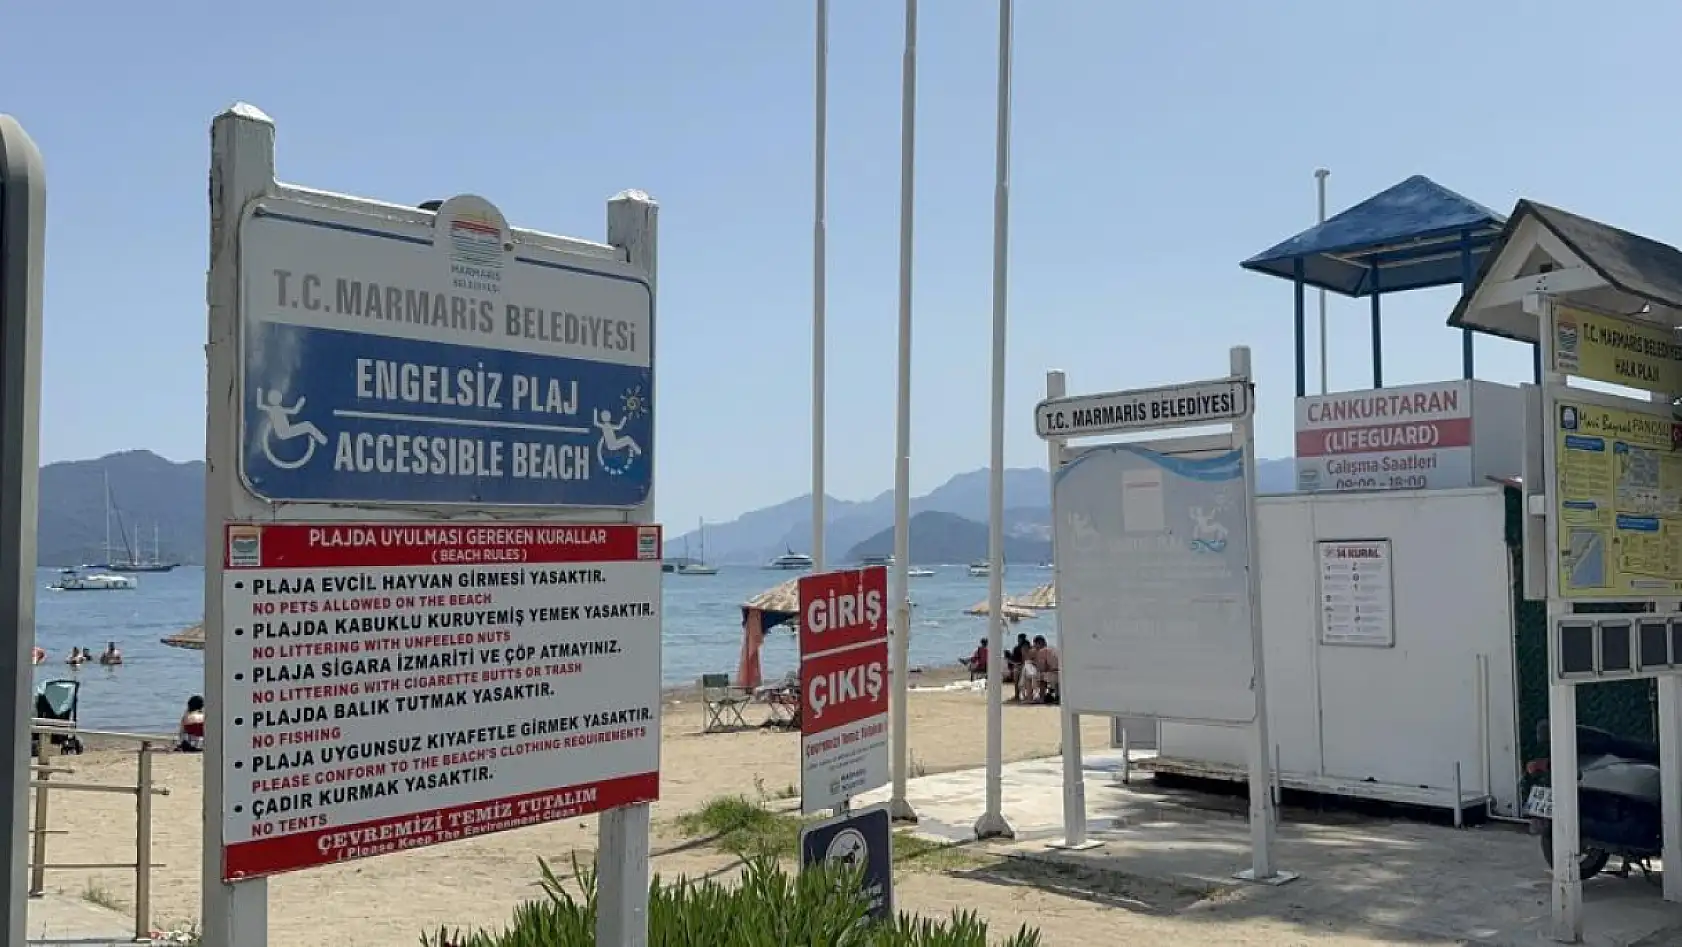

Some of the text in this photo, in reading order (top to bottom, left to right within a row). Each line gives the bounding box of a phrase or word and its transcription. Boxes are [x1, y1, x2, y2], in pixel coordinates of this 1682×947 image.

[356, 357, 579, 416] ENGELSİZ PLAJ
[1307, 389, 1458, 422] CANKURTARAN
[1046, 412, 1070, 430] T.C.
[1072, 399, 1146, 428] MARMARİS
[334, 431, 591, 480] ACCESSIBLE BEACH
[1324, 424, 1440, 453] (LIFEGUARD)
[1382, 453, 1438, 472] Saatleri
[309, 528, 606, 547] PLAJDA UYULMASI GEREKEN KURALLAR
[252, 567, 606, 596] PLAJA EVCİL HAYVAN GİRMESİ YASAKTIR.
[252, 593, 493, 616] NO PETS ALLOWED ON THE BEACH
[252, 602, 655, 640] PLAJDA KABUKLU KURUYEMİŞ YEMEK YASAKTIR.
[807, 584, 882, 633] GİRİŞ
[252, 630, 511, 661] NO LITTERING WITH UNPEELED NUTS
[252, 640, 622, 684] PLAJA SİGARA İZMARİTİ VE ÇÖP ATMAYINIZ.
[252, 663, 583, 704] NO LITTERING WITH CIGARETTE BUTTS OR TRASH
[808, 662, 882, 719] ÇIKIŞ
[252, 682, 555, 729] PLAJDA BALIK TUTMAK YASAKTIR.
[252, 726, 342, 749] NO FISHING
[252, 707, 653, 772] PLAJA UYGUNSUZ KIYAFETLE GİRMEK YASAKTIR.
[252, 725, 647, 794] PLEASE CONFORM TO THE BEACH'S CLOTHING REQUIREMENTS
[252, 765, 493, 820] ÇADIR KURMAK YASAKTIR.
[252, 813, 328, 838] NO TENTS
[317, 787, 597, 856] ÇEVREMİZİ TEMİZ TUTALIM
